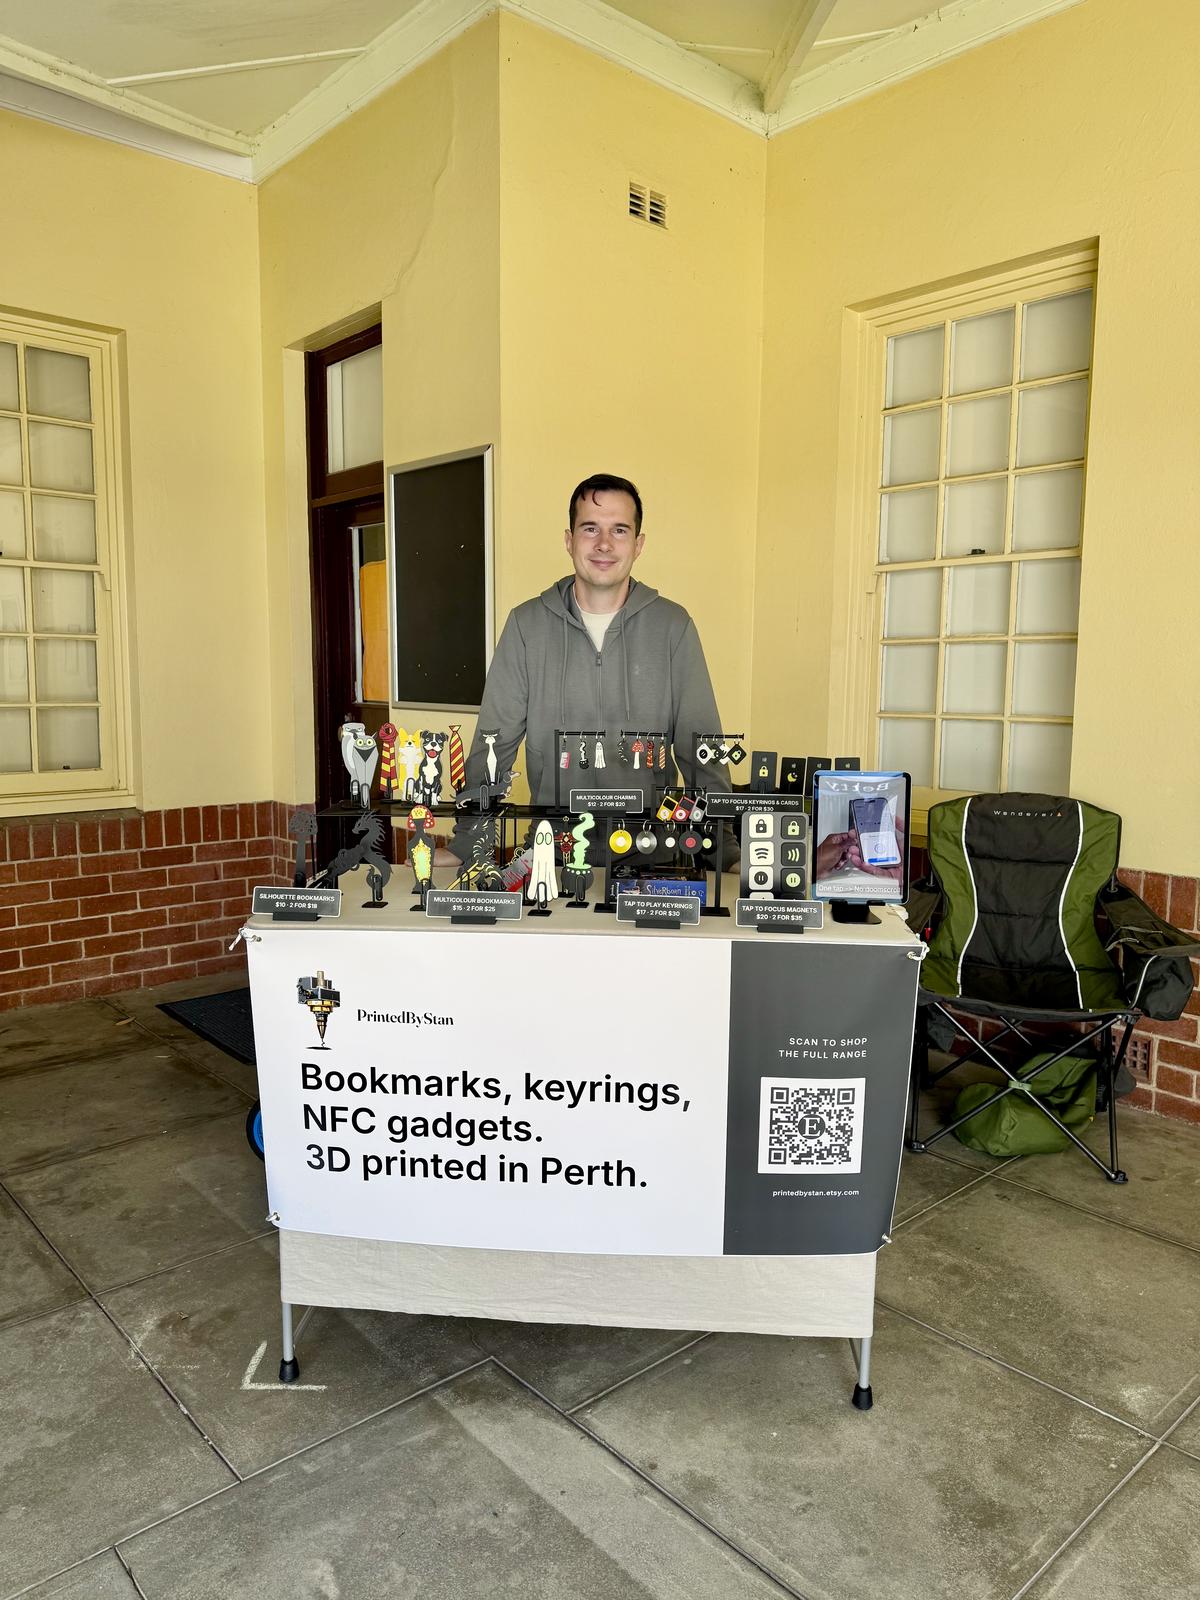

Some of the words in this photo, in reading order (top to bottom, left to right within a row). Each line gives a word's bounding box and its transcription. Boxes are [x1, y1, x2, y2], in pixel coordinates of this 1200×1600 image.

[357, 1009, 454, 1028] PrintedByStan
[789, 1037, 818, 1046] SCAN
[822, 1038, 836, 1046] TO
[840, 1037, 868, 1046] SHOP
[778, 1050, 799, 1058] THE
[803, 1050, 828, 1059] FULL
[832, 1050, 867, 1058] RANGE
[300, 1062, 512, 1106] Bookmarks,
[524, 1072, 692, 1112] keyrings,
[303, 1103, 376, 1135] NFC
[388, 1111, 543, 1146] gadgets.
[802, 1117, 821, 1137] E
[306, 1143, 351, 1172] 3D
[362, 1149, 487, 1182] printed
[498, 1154, 529, 1184] in
[540, 1156, 648, 1188] Perth.
[772, 1189, 860, 1198] printedbystan.etsy.com
